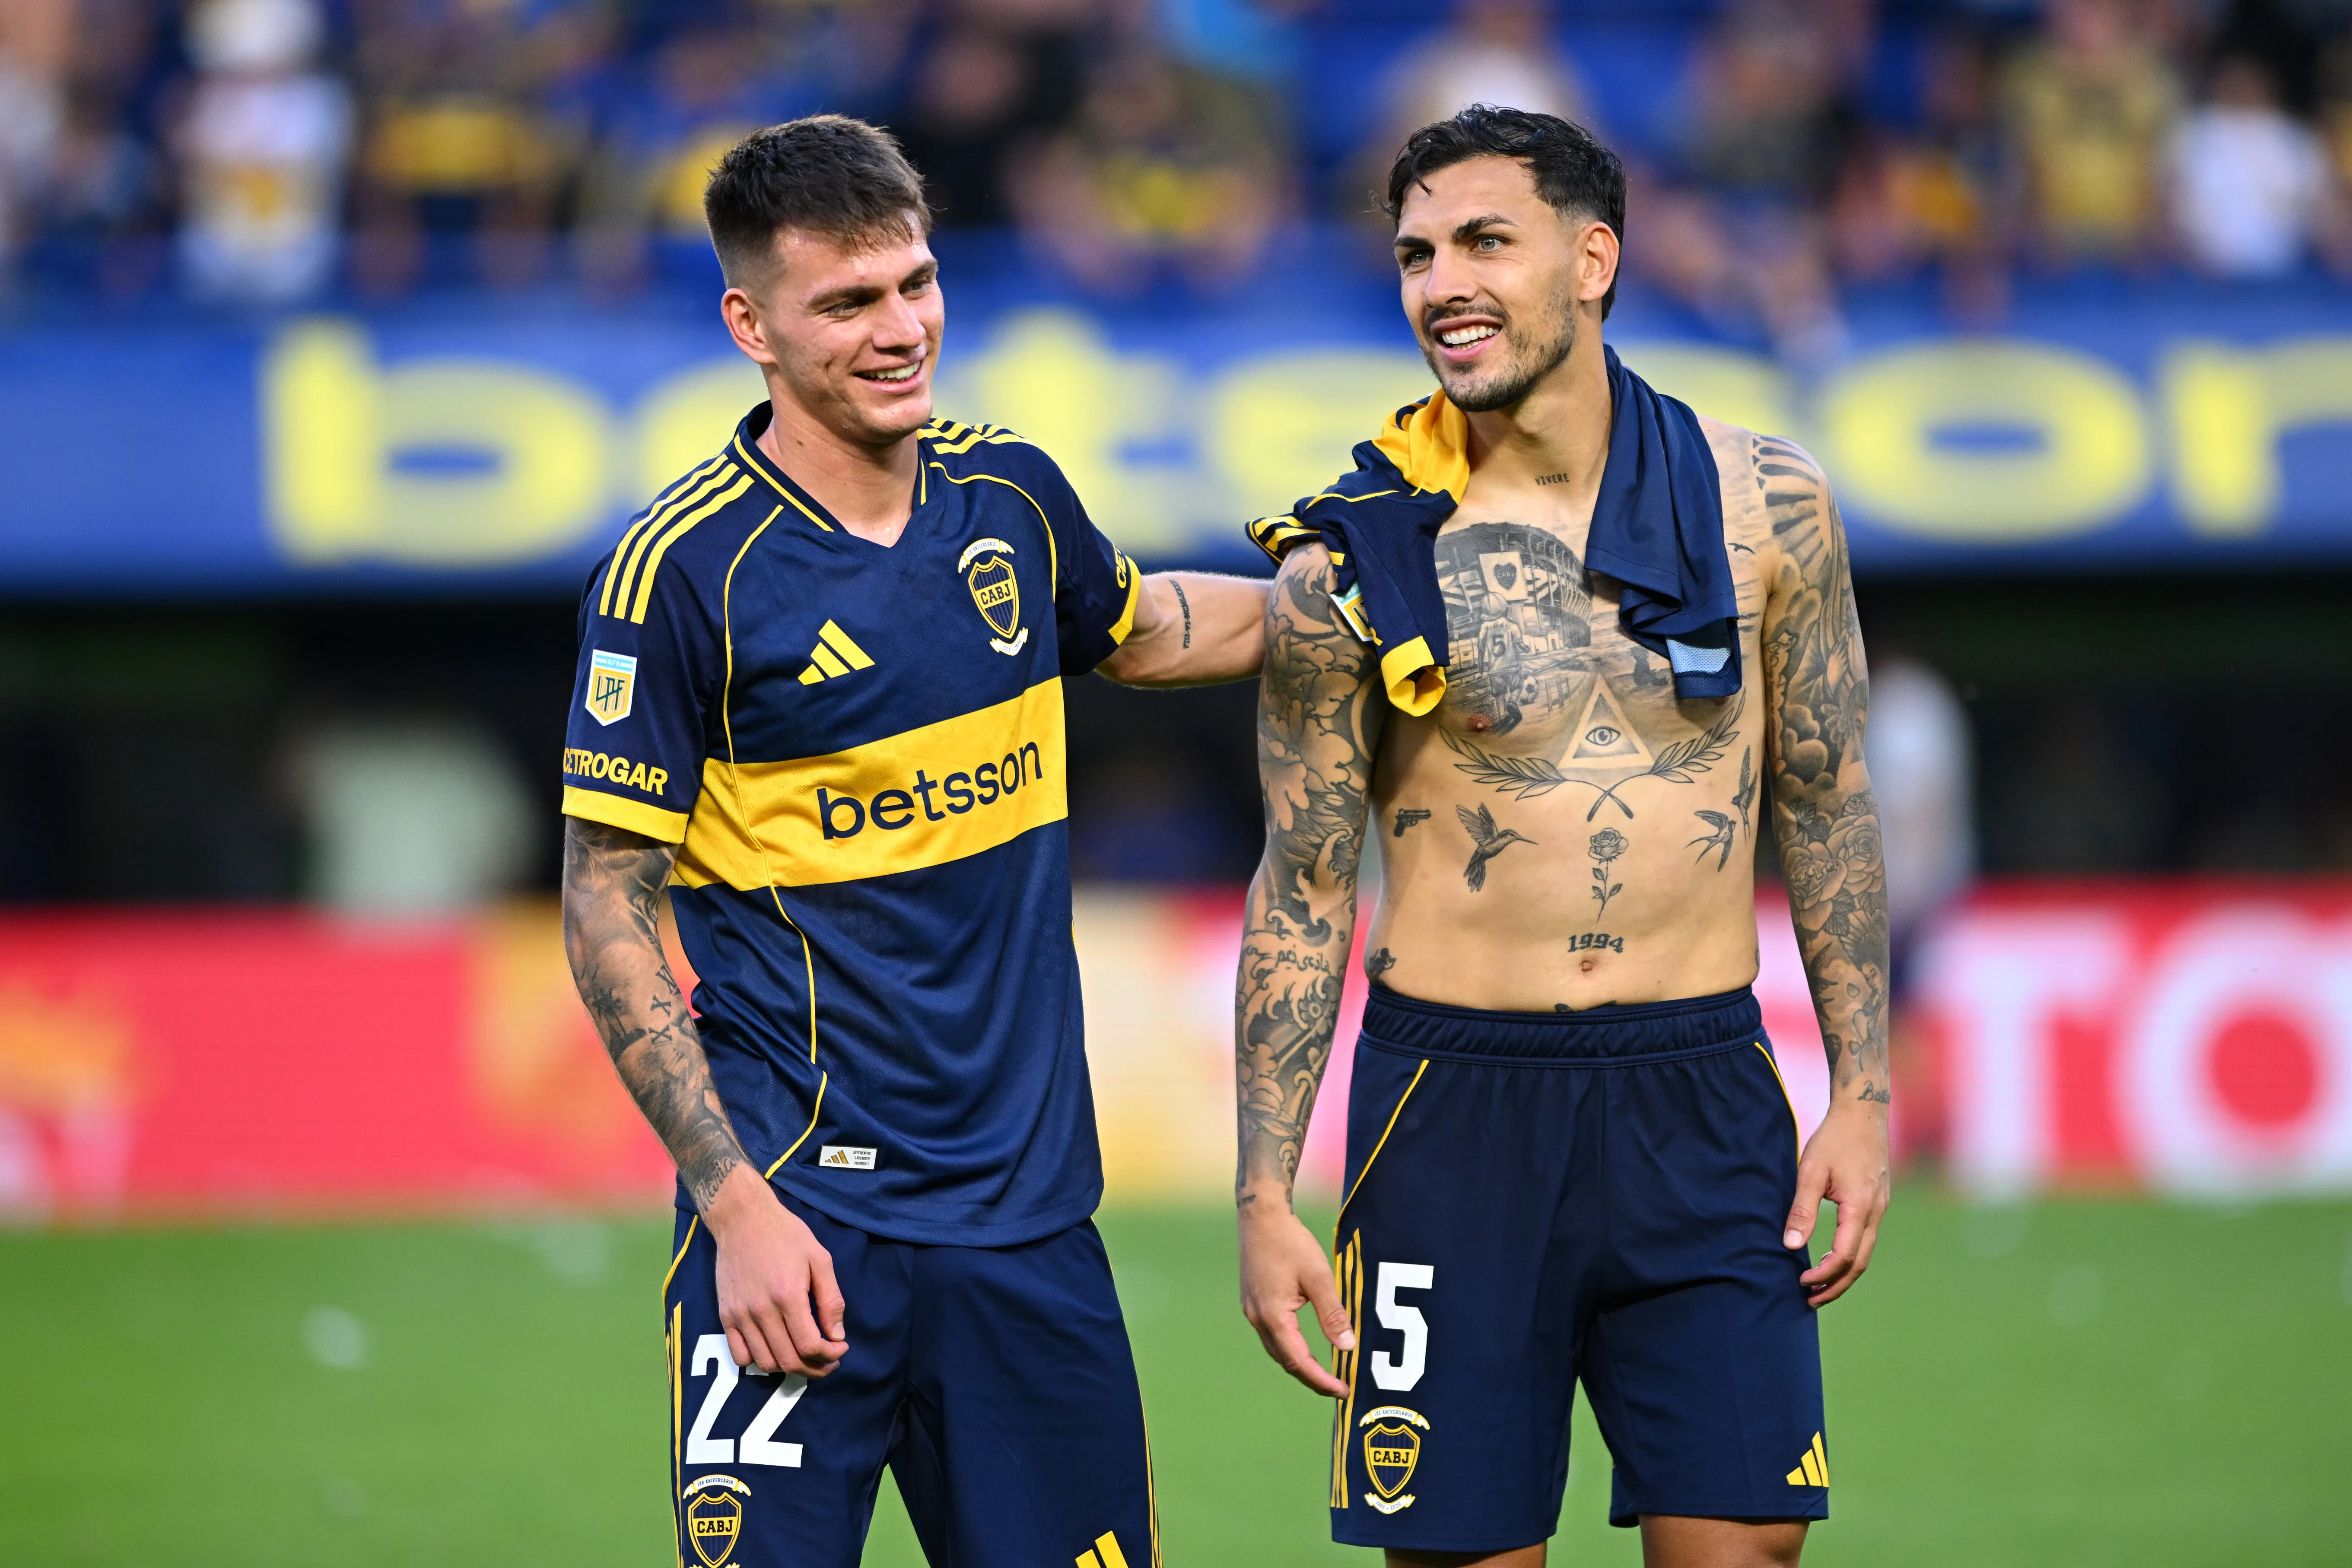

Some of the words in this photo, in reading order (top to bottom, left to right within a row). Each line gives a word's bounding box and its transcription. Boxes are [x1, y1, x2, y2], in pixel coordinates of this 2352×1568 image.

[1535, 473, 1570, 486] VIVERE
[973, 542, 996, 552] ANIVERSARIO
[980, 584, 1011, 605] CABJ
[1492, 634, 1506, 657] 5
[563, 747, 668, 796] CETROGAR
[817, 742, 1043, 840] betsson
[1567, 933, 1624, 953] 1994
[1371, 1262, 1434, 1392] 5
[686, 1334, 808, 1468] 22
[1383, 1409, 1413, 1418] ANIVERSARIO
[1374, 1451, 1410, 1464] CABJ
[697, 1520, 733, 1533] CABJ
